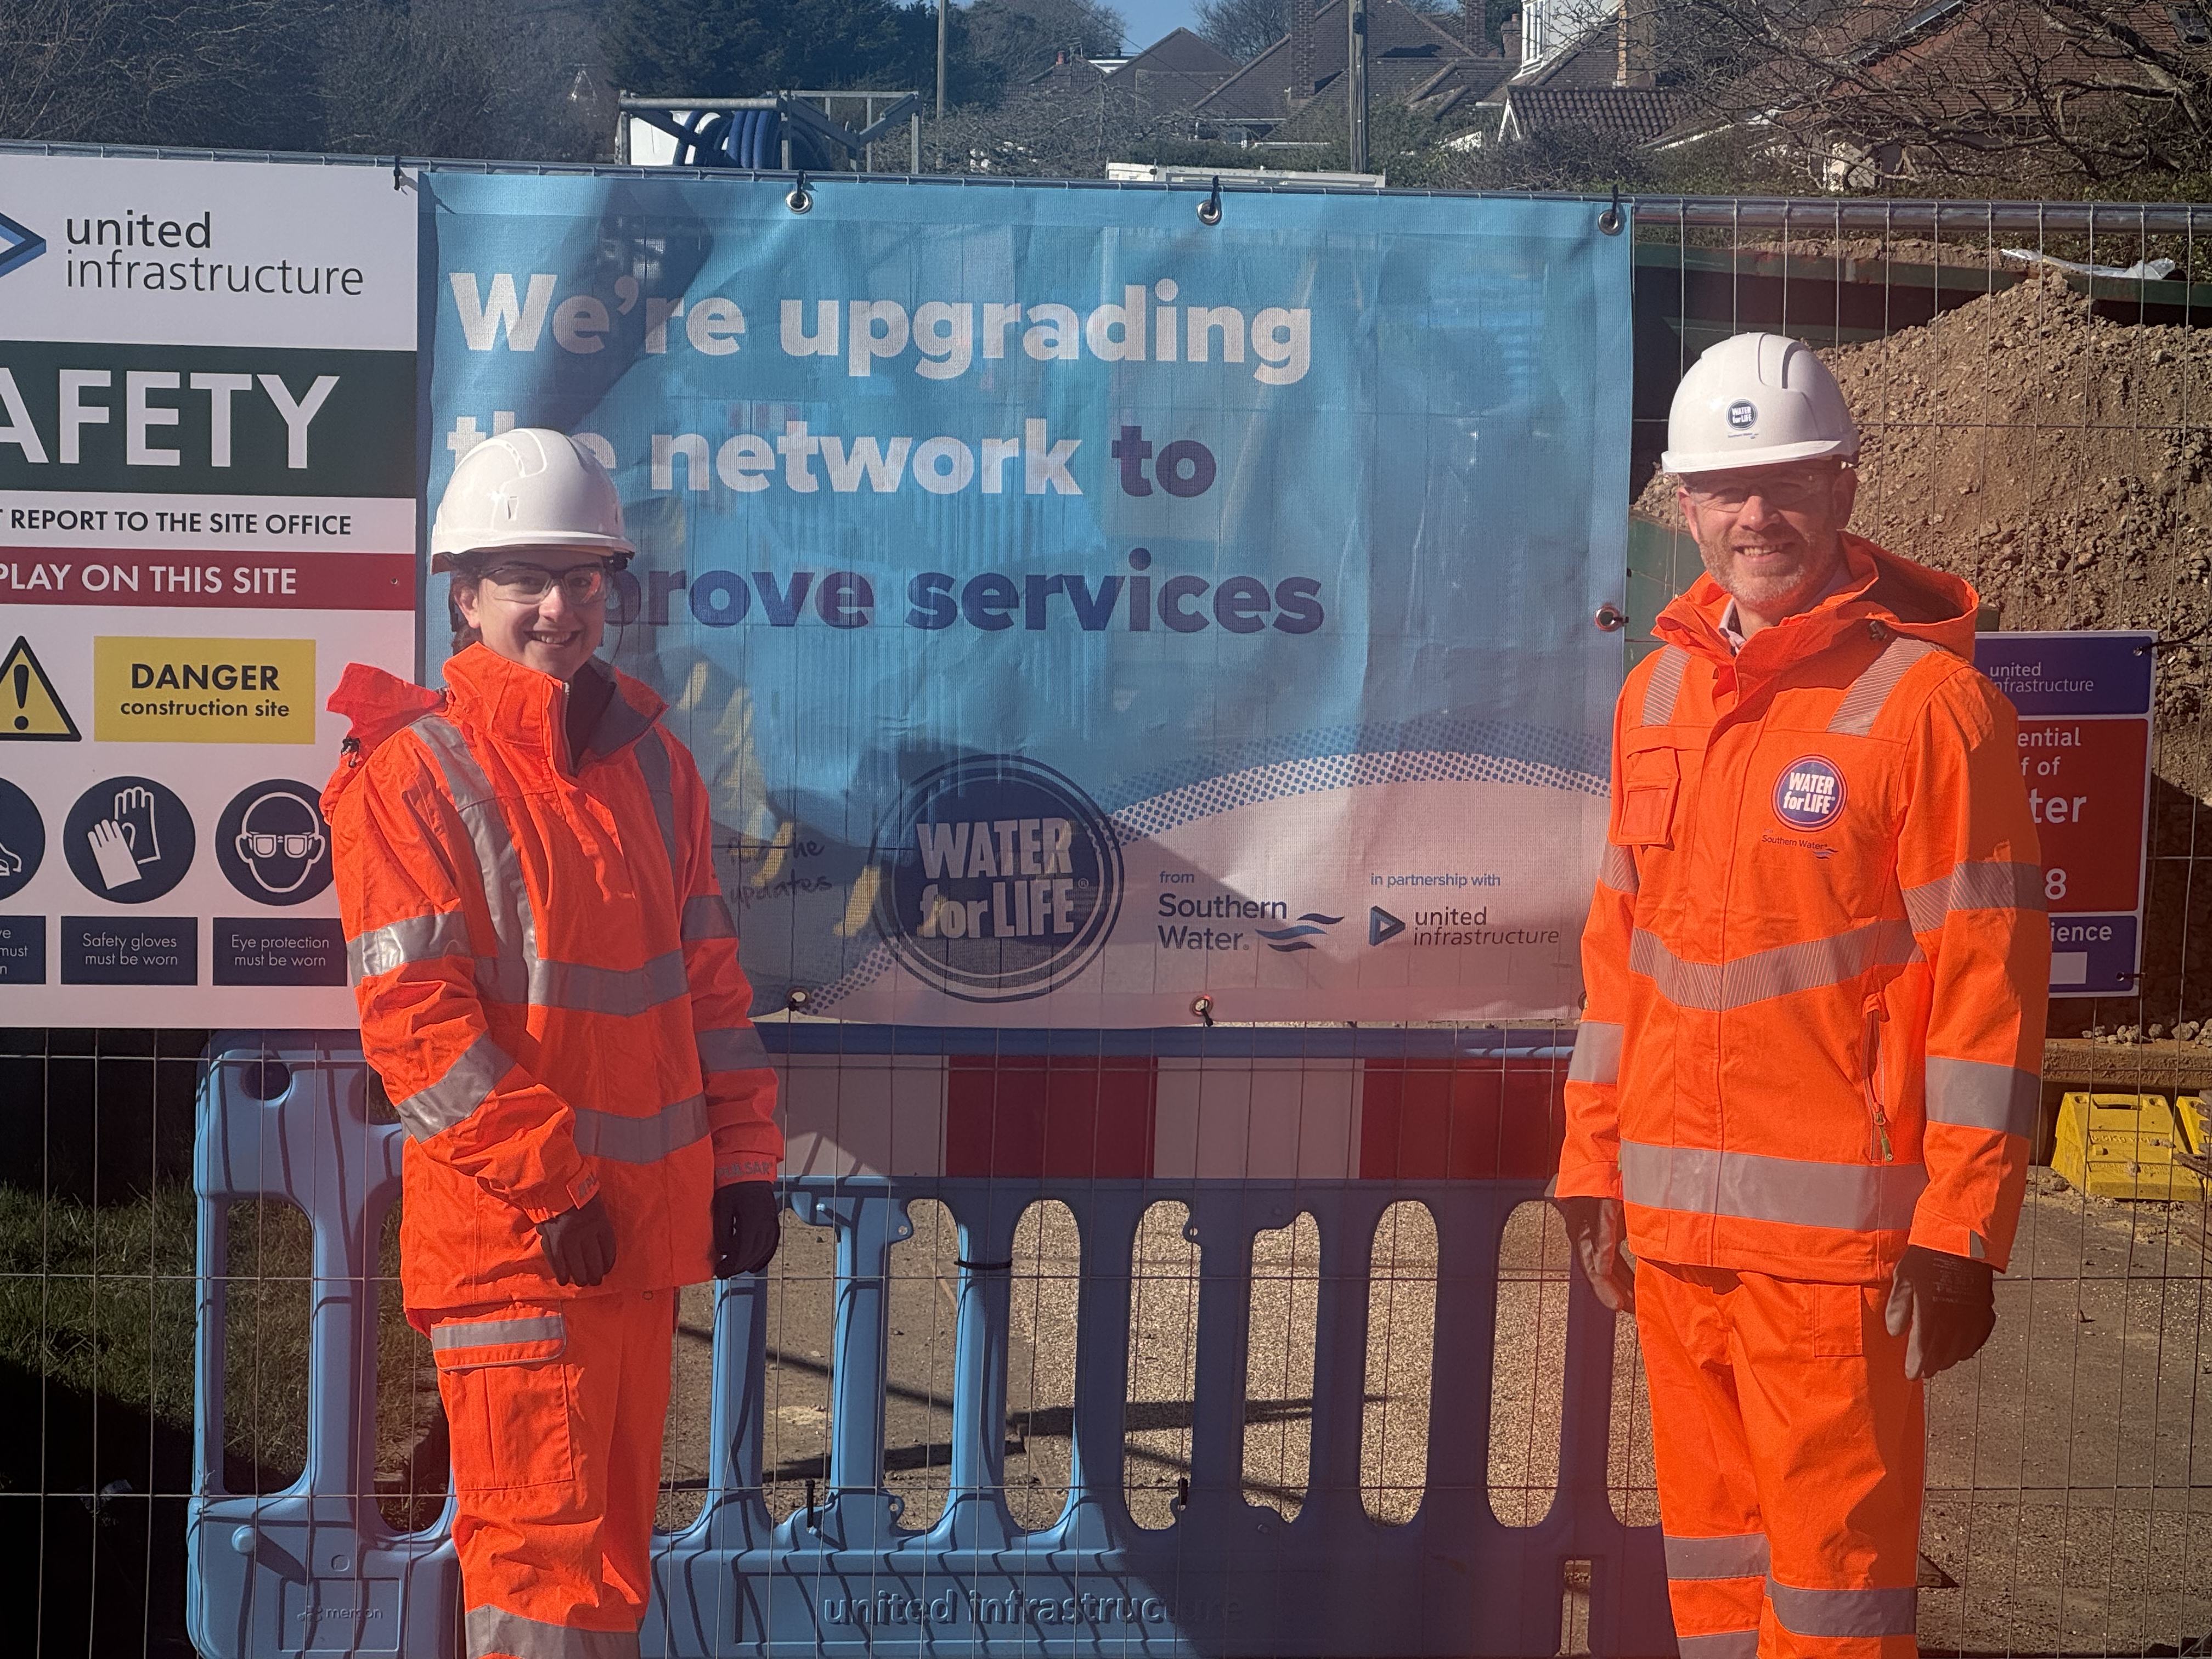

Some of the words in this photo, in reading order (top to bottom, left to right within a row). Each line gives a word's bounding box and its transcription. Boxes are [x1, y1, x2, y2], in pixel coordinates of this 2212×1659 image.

[66, 210, 211, 248] united
[66, 250, 363, 295] infrastructure
[780, 278, 1312, 385] upgrading
[1732, 407, 1752, 416] WATER
[651, 418, 1083, 495] network
[1111, 426, 1217, 498] to
[12, 509, 108, 531] REPORT
[115, 511, 148, 531] TO
[156, 512, 201, 532] THE
[210, 514, 257, 533] SITE
[266, 515, 352, 535] OFFICE
[82, 565, 139, 592] ON
[149, 566, 222, 594] THIS
[233, 567, 296, 595] SITE
[602, 569, 874, 629] prove
[906, 548, 1324, 634] services
[132, 663, 280, 691] DANGER
[1990, 662, 2041, 676] united
[1990, 677, 2094, 693] nfrastructure
[121, 698, 247, 716] construction
[255, 699, 290, 717] site
[2018, 727, 2081, 747] ential
[2037, 756, 2061, 776] of
[1789, 772, 1835, 795] WATER
[2029, 788, 2086, 823] ter
[917, 818, 1072, 879] WATER
[1762, 835, 1797, 847] Southern
[1160, 871, 1195, 883] from
[1371, 873, 1383, 886] in
[1387, 873, 1468, 888] partnership
[1471, 873, 1501, 886] with
[919, 883, 988, 939] for
[1158, 893, 1287, 919] Southern
[1415, 906, 1487, 926] united
[82, 933, 127, 949] Safety
[131, 934, 177, 949] gloves
[232, 935, 257, 950] Eye
[261, 934, 329, 950] protection
[1414, 926, 1559, 946] infrastructure
[2051, 922, 2112, 942] ience
[0, 945, 28, 957] must
[85, 952, 115, 966] must
[120, 952, 138, 966] be
[143, 954, 178, 966] worn
[234, 953, 264, 967] must
[268, 953, 288, 967] be
[291, 956, 326, 967] worn
[823, 1589, 957, 1626] united
